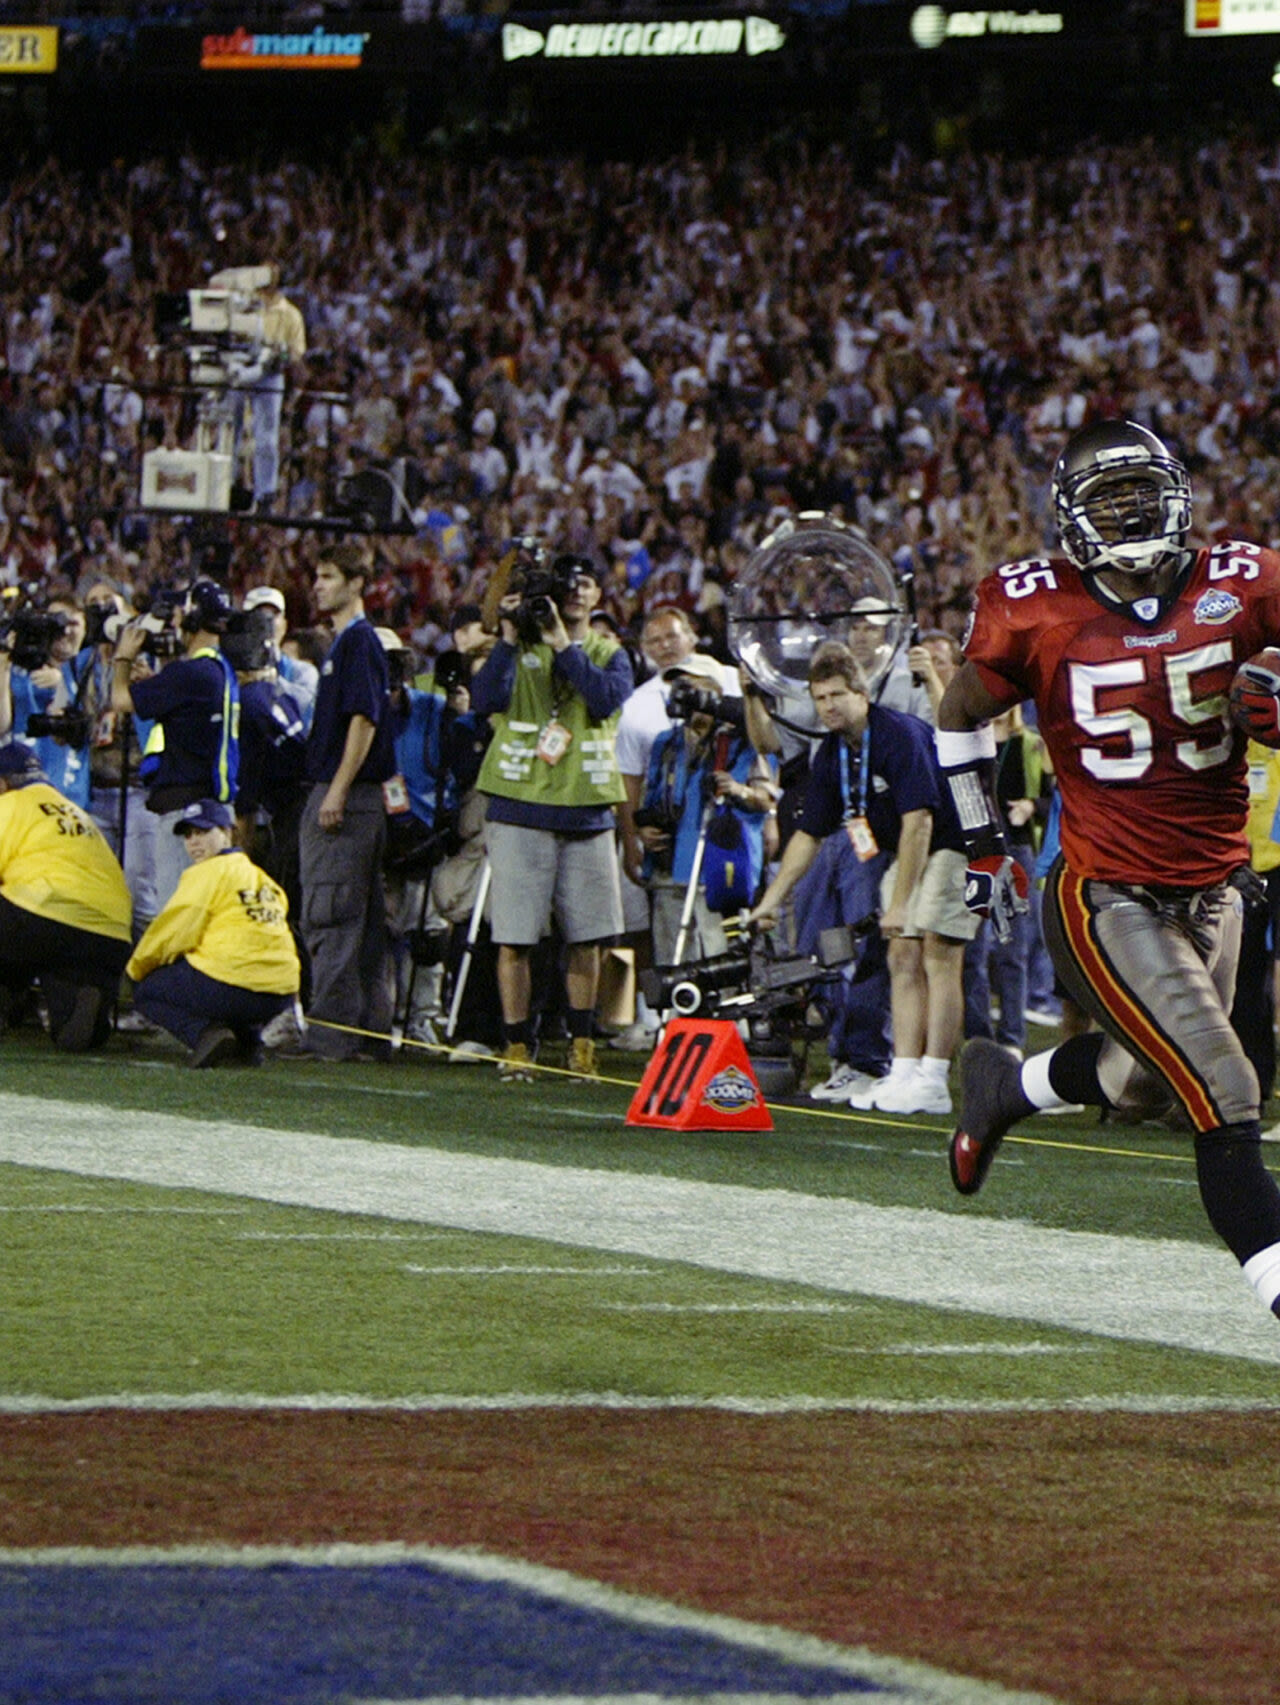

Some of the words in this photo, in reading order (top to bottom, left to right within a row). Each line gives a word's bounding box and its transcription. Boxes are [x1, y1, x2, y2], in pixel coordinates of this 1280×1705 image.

[998, 558, 1058, 599] 55
[1208, 540, 1261, 581] 55
[1068, 640, 1234, 781] 55
[640, 1031, 714, 1116] 10
